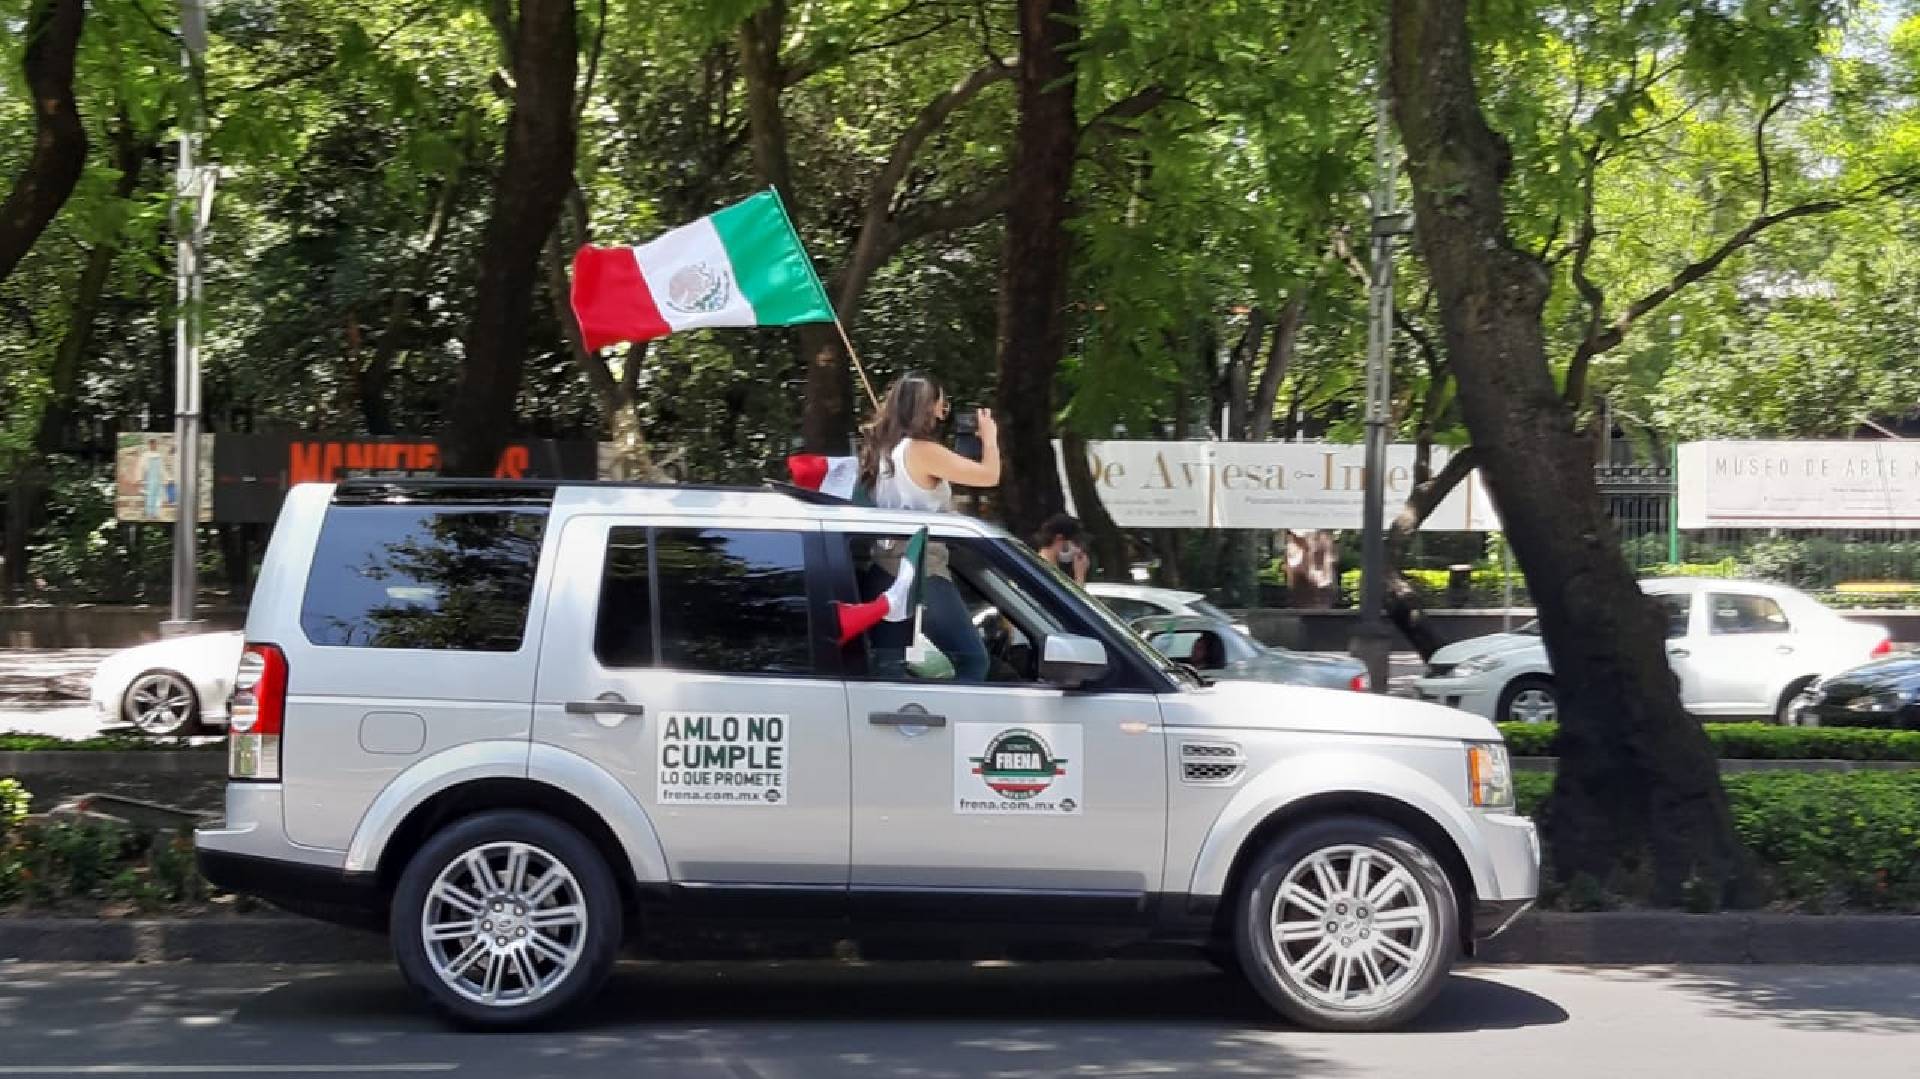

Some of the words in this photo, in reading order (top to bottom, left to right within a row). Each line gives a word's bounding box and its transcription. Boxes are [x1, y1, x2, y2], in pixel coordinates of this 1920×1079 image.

[1715, 457, 1790, 477] MUSEO
[1805, 457, 1830, 477] DE
[1846, 457, 1898, 478] ARTE
[664, 716, 739, 742] AMLO
[747, 716, 783, 742] NO
[663, 744, 784, 769] CUMPLE
[996, 752, 1042, 770] FRENA
[661, 771, 679, 785] LO
[683, 771, 712, 786] QUE
[714, 772, 782, 787] PROMETE
[663, 789, 760, 801] frena.com.mx
[960, 798, 1056, 811] frena.com.mx
